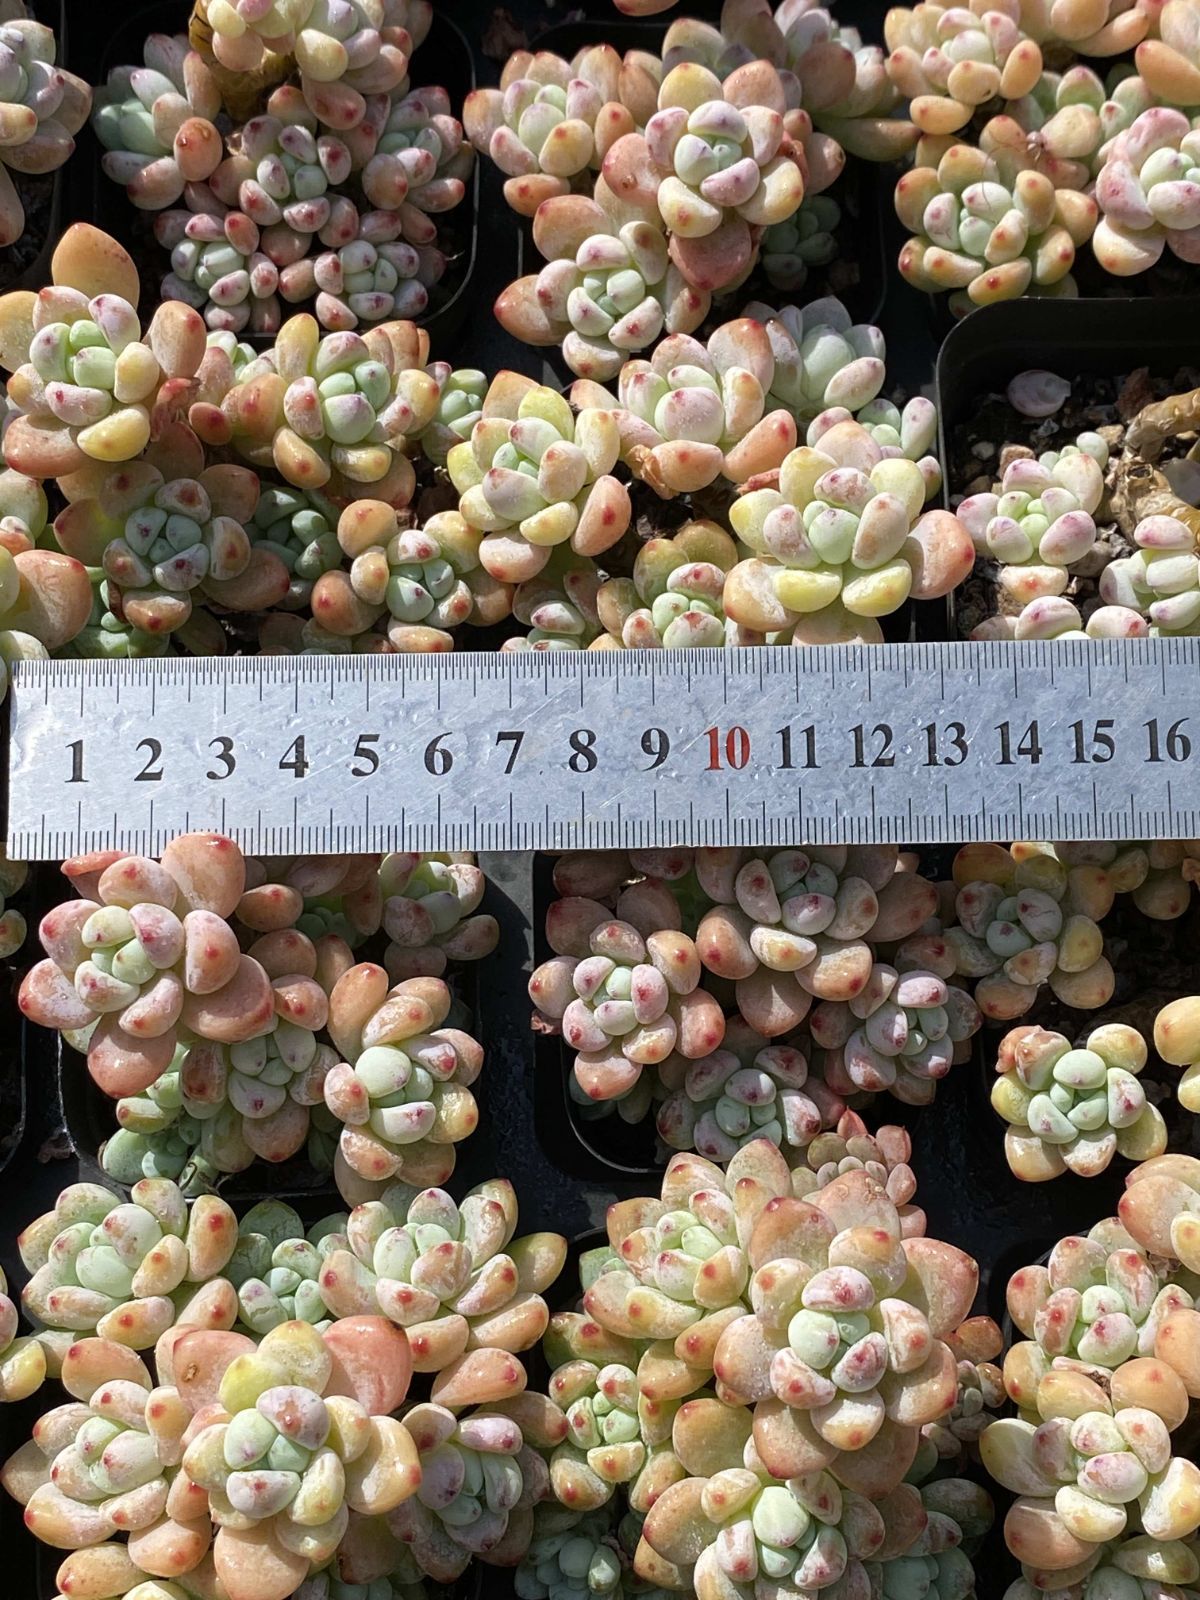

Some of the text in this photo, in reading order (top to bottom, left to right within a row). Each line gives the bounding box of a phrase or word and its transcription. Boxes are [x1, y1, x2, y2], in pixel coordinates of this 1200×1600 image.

[64, 717, 1192, 783] 1 2 3 4 5 6 7 8 9 10 11 12 13 14 15 16
